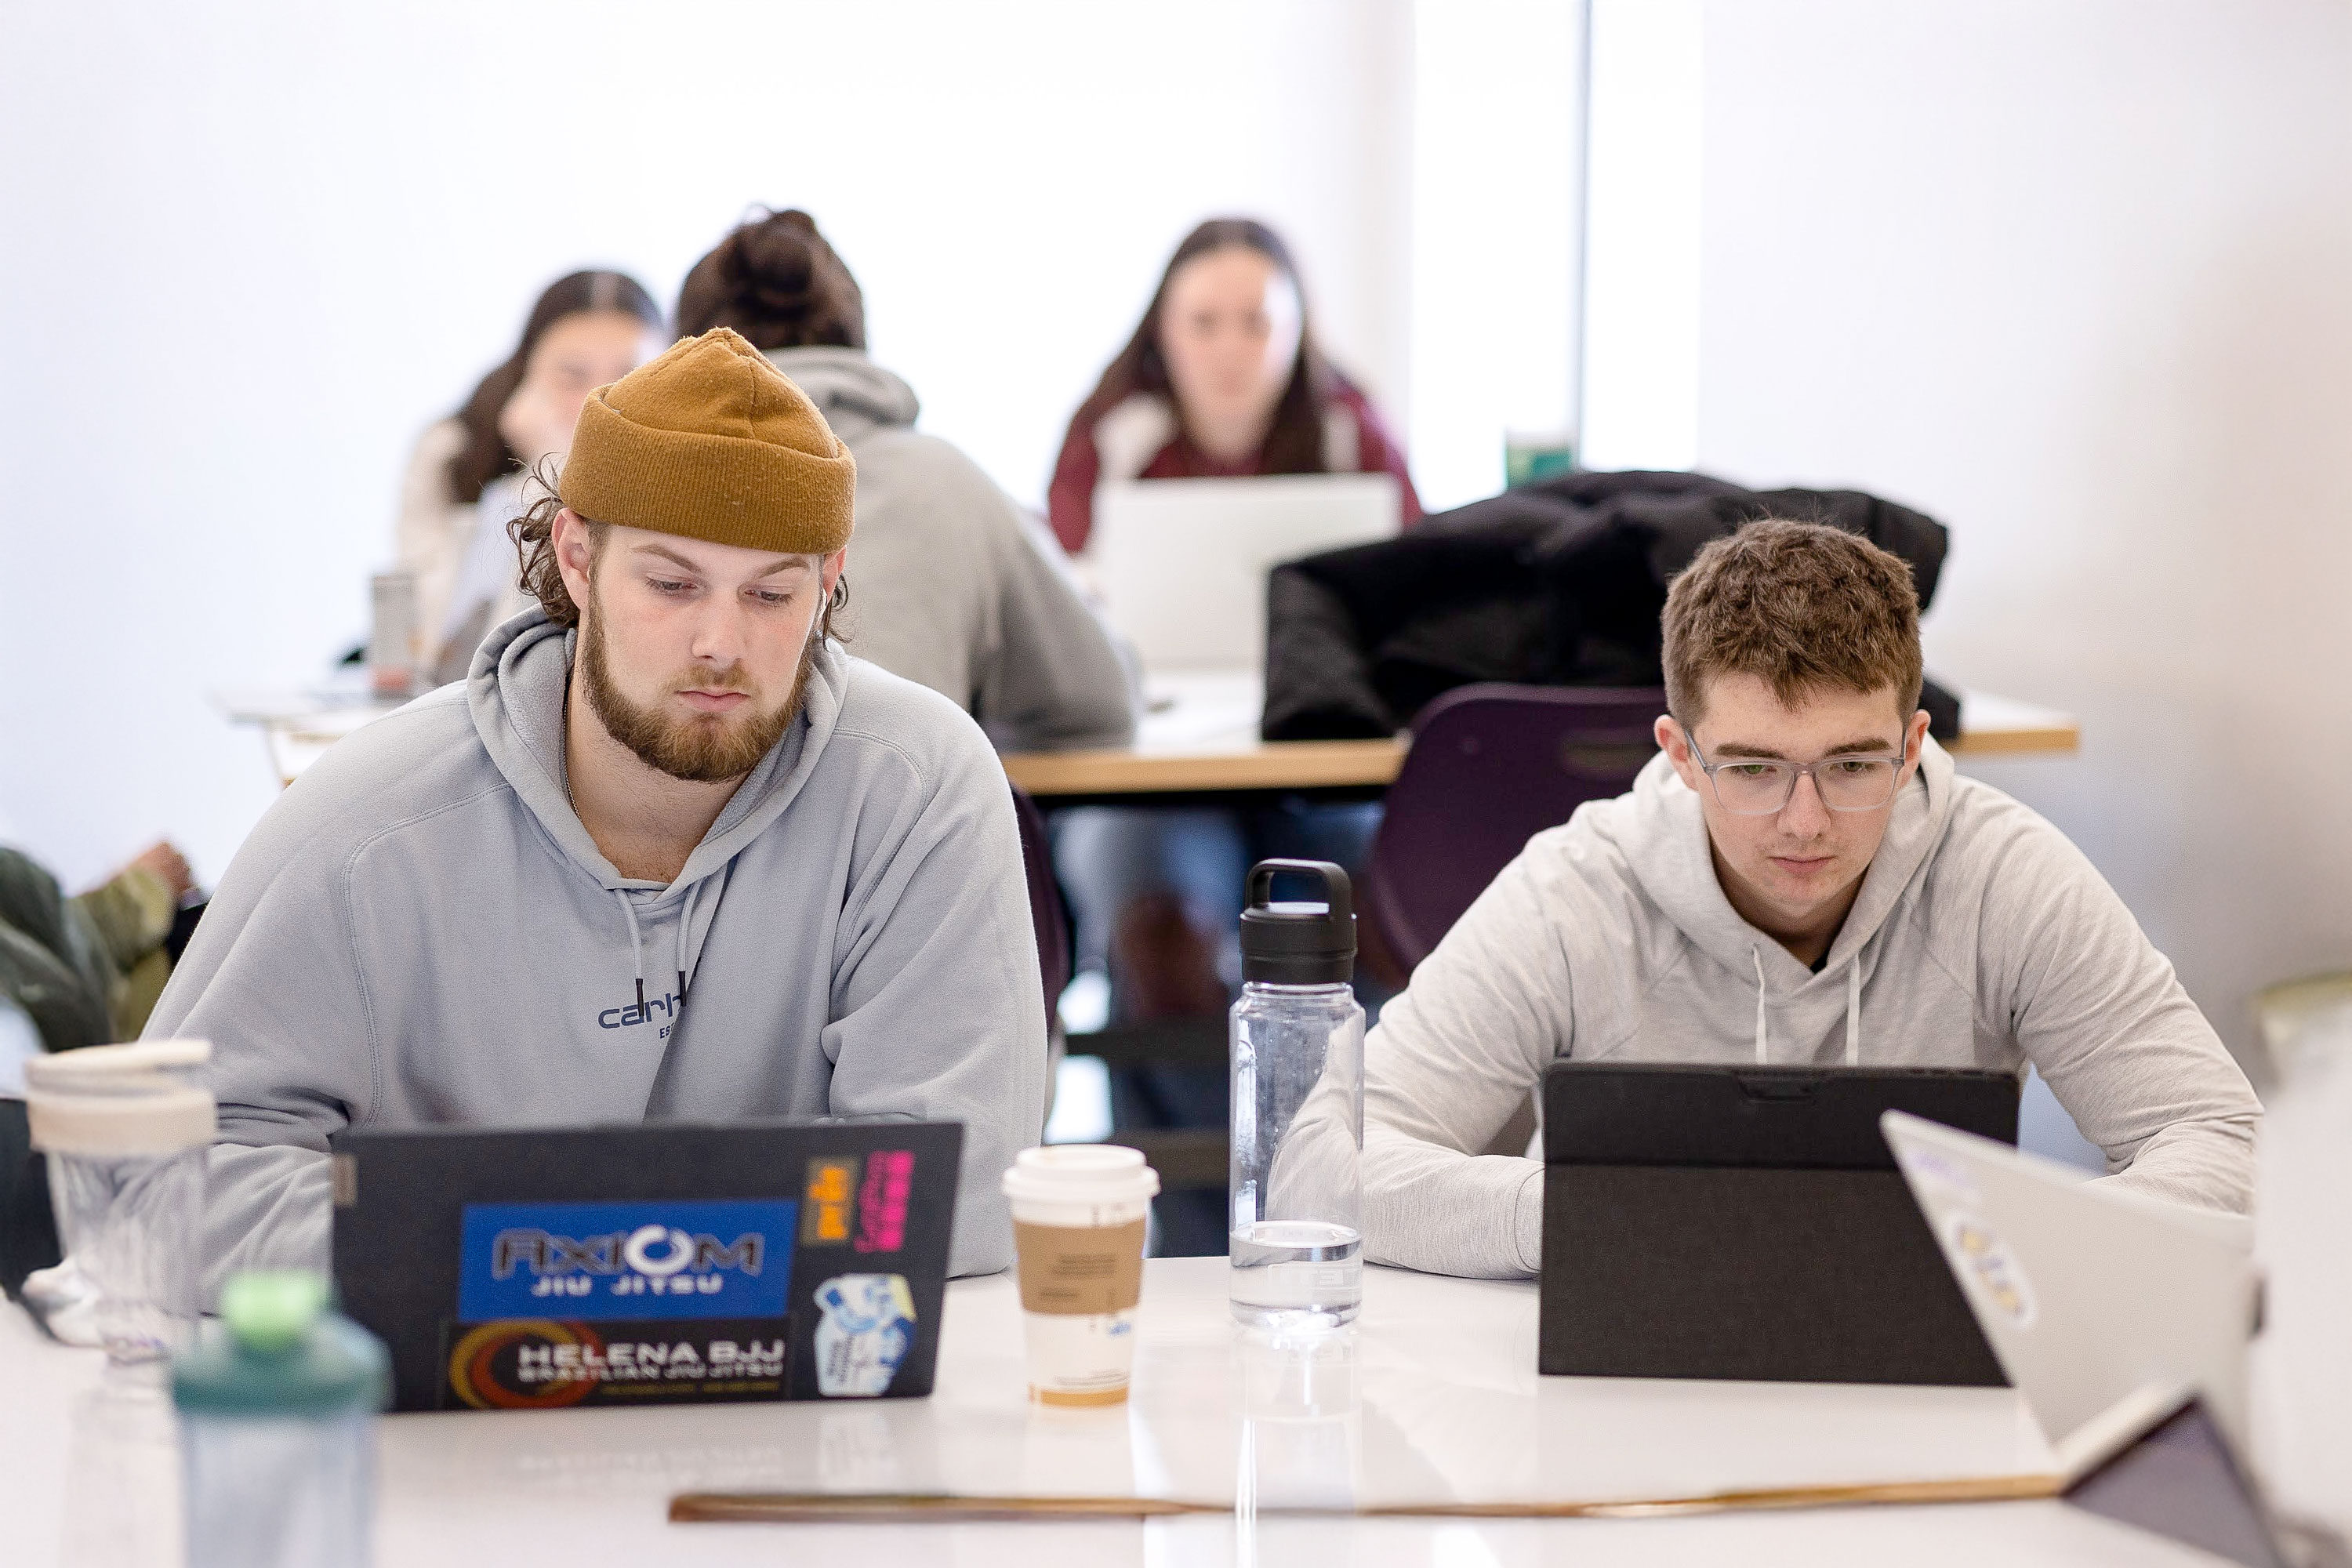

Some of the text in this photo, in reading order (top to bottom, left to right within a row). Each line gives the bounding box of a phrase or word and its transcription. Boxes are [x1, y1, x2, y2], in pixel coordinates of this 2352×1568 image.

[491, 1225, 766, 1280] AXIOM
[530, 1273, 724, 1297] JIU JITSU
[517, 1338, 785, 1367] HELENA BJJ
